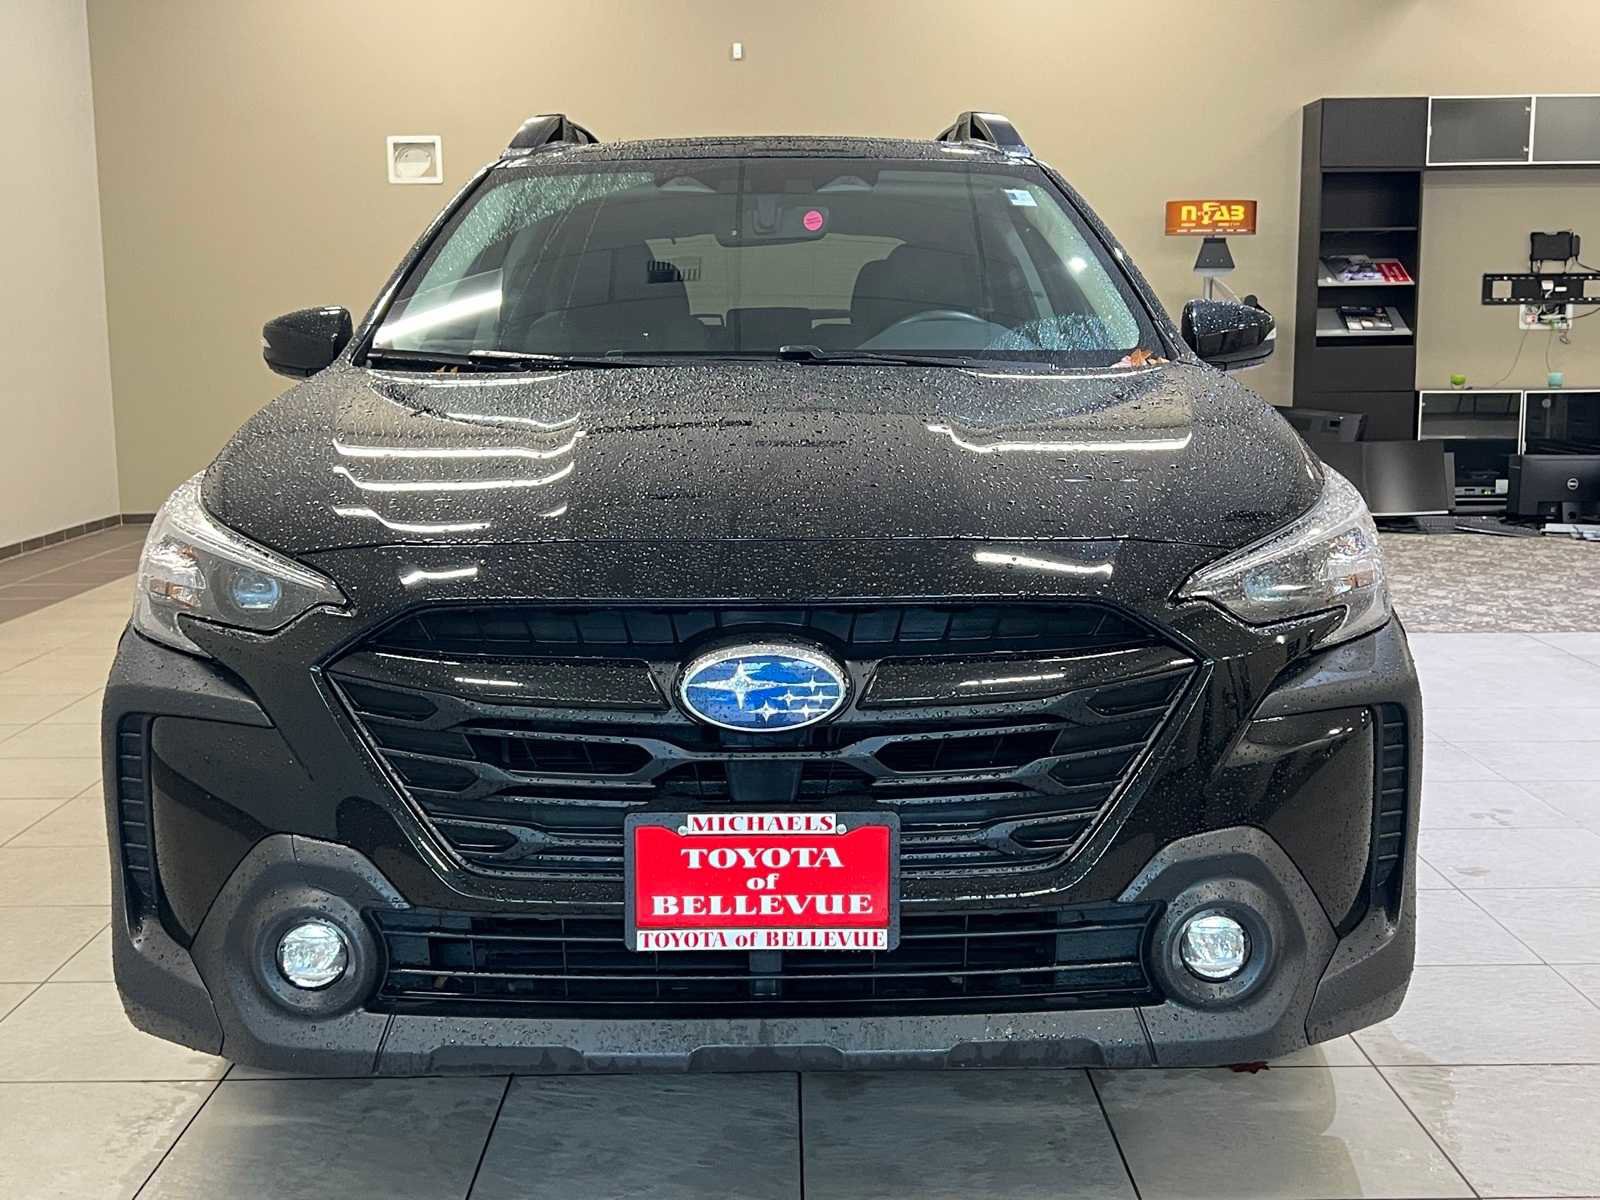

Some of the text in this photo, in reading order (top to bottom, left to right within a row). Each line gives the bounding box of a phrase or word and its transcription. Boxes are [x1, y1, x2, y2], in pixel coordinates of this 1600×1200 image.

[691, 816, 833, 832] MICHAELS
[680, 847, 844, 869] TOYOTA
[746, 873, 780, 890] of
[651, 894, 873, 916] BELLEVUE
[640, 931, 885, 948] TOYOTA of BELLEVUE
